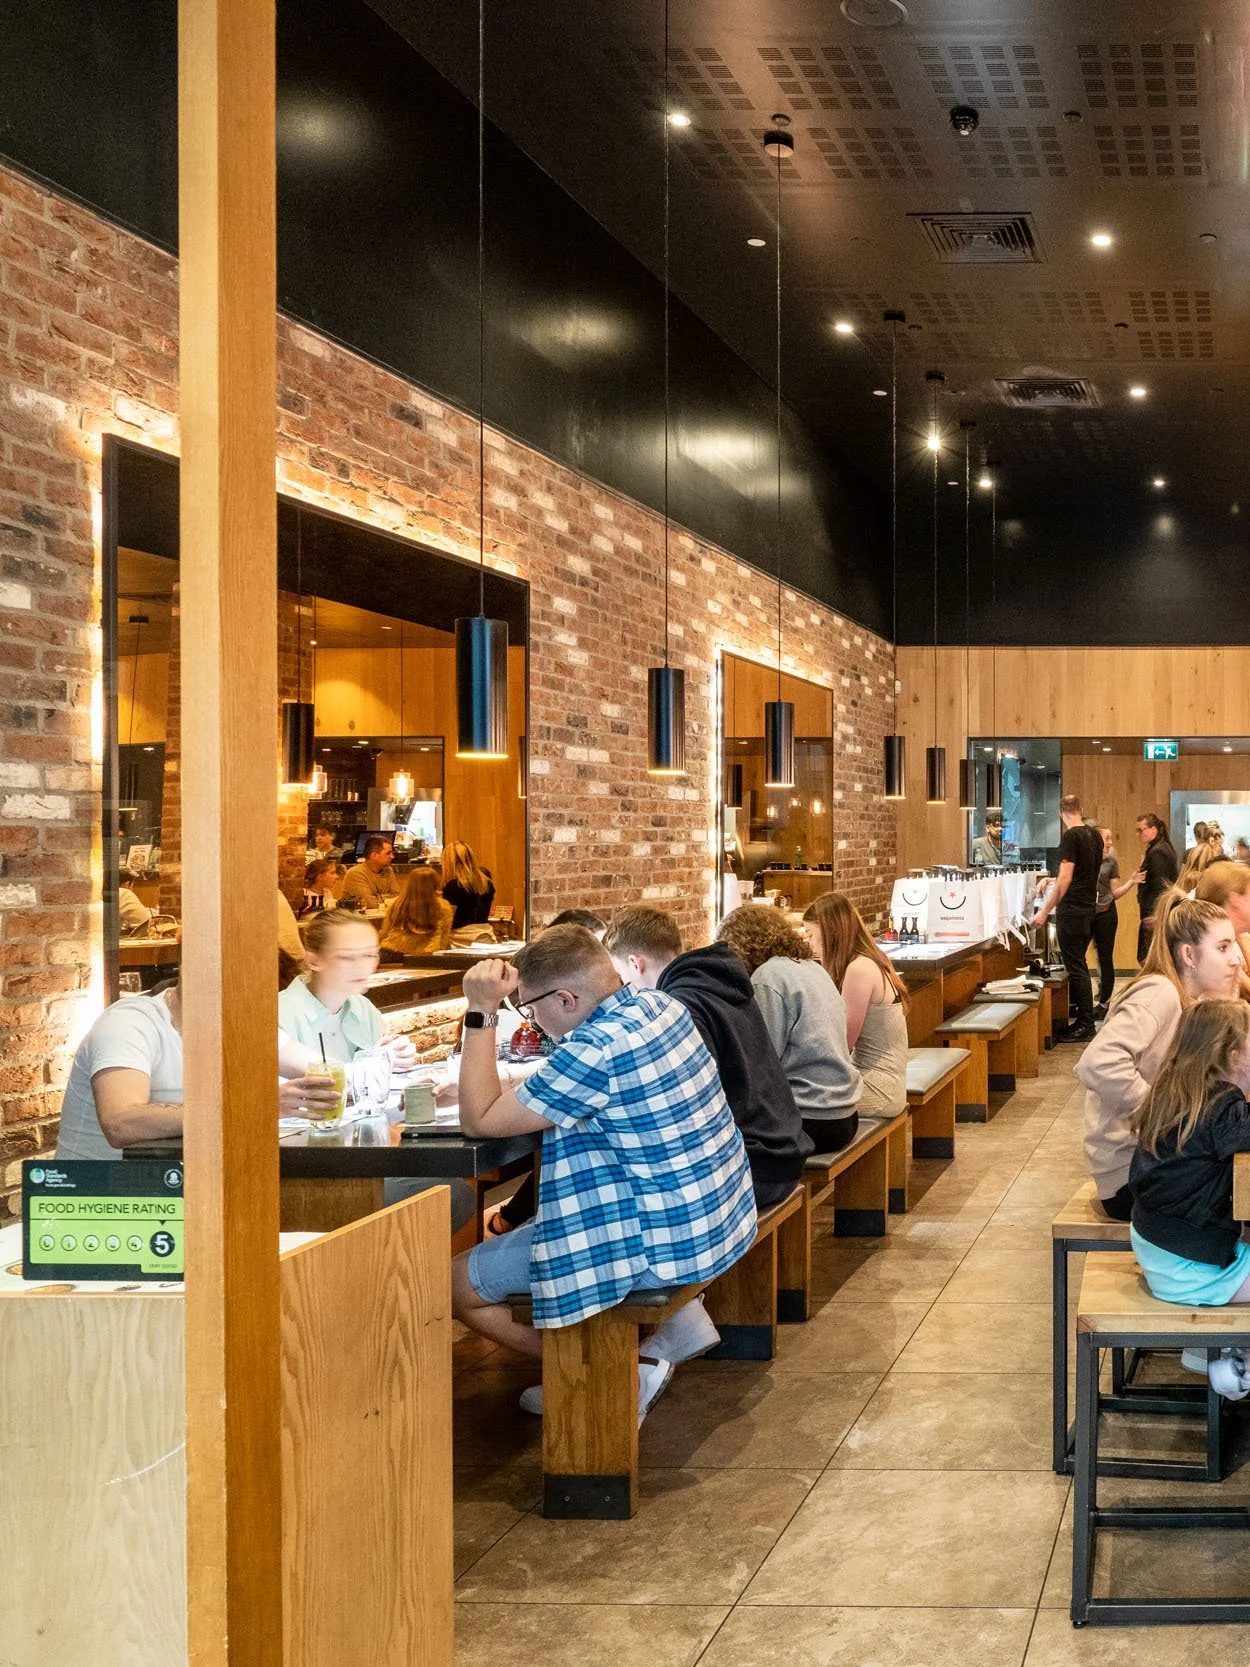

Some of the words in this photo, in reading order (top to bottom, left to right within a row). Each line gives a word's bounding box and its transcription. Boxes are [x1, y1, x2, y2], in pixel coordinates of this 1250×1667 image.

[38, 1202, 75, 1214] FOOD
[78, 1203, 130, 1214] HYGIENE
[132, 1203, 176, 1215] RATING
[154, 1234, 170, 1255] 5
